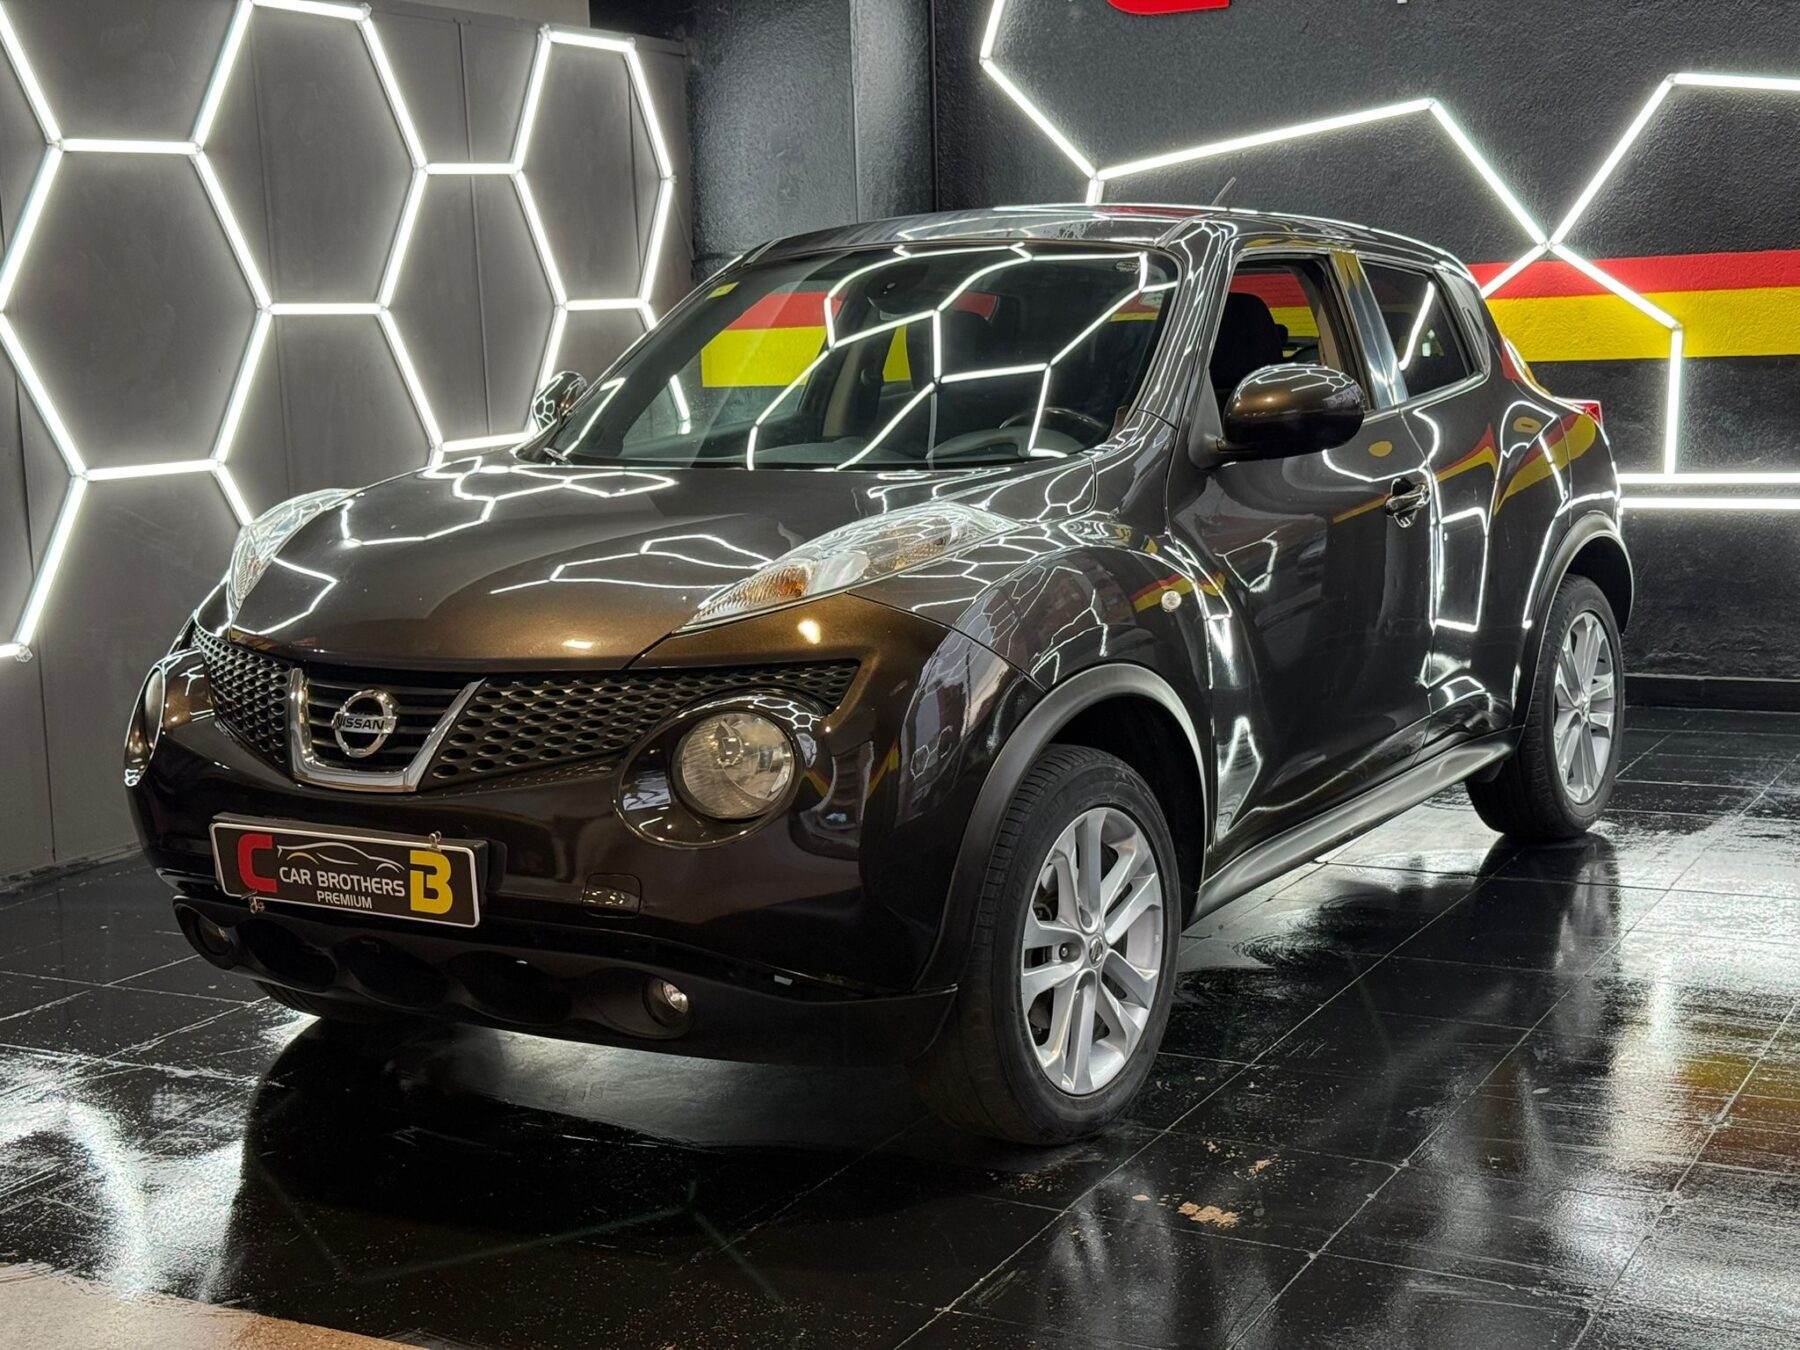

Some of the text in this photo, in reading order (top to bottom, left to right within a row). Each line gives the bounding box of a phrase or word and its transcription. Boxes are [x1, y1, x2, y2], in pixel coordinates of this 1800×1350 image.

[337, 716, 385, 731] NISSAN
[237, 833, 278, 893] C
[279, 866, 406, 897] CAR BROTHERS
[316, 890, 373, 909] PREMIUM
